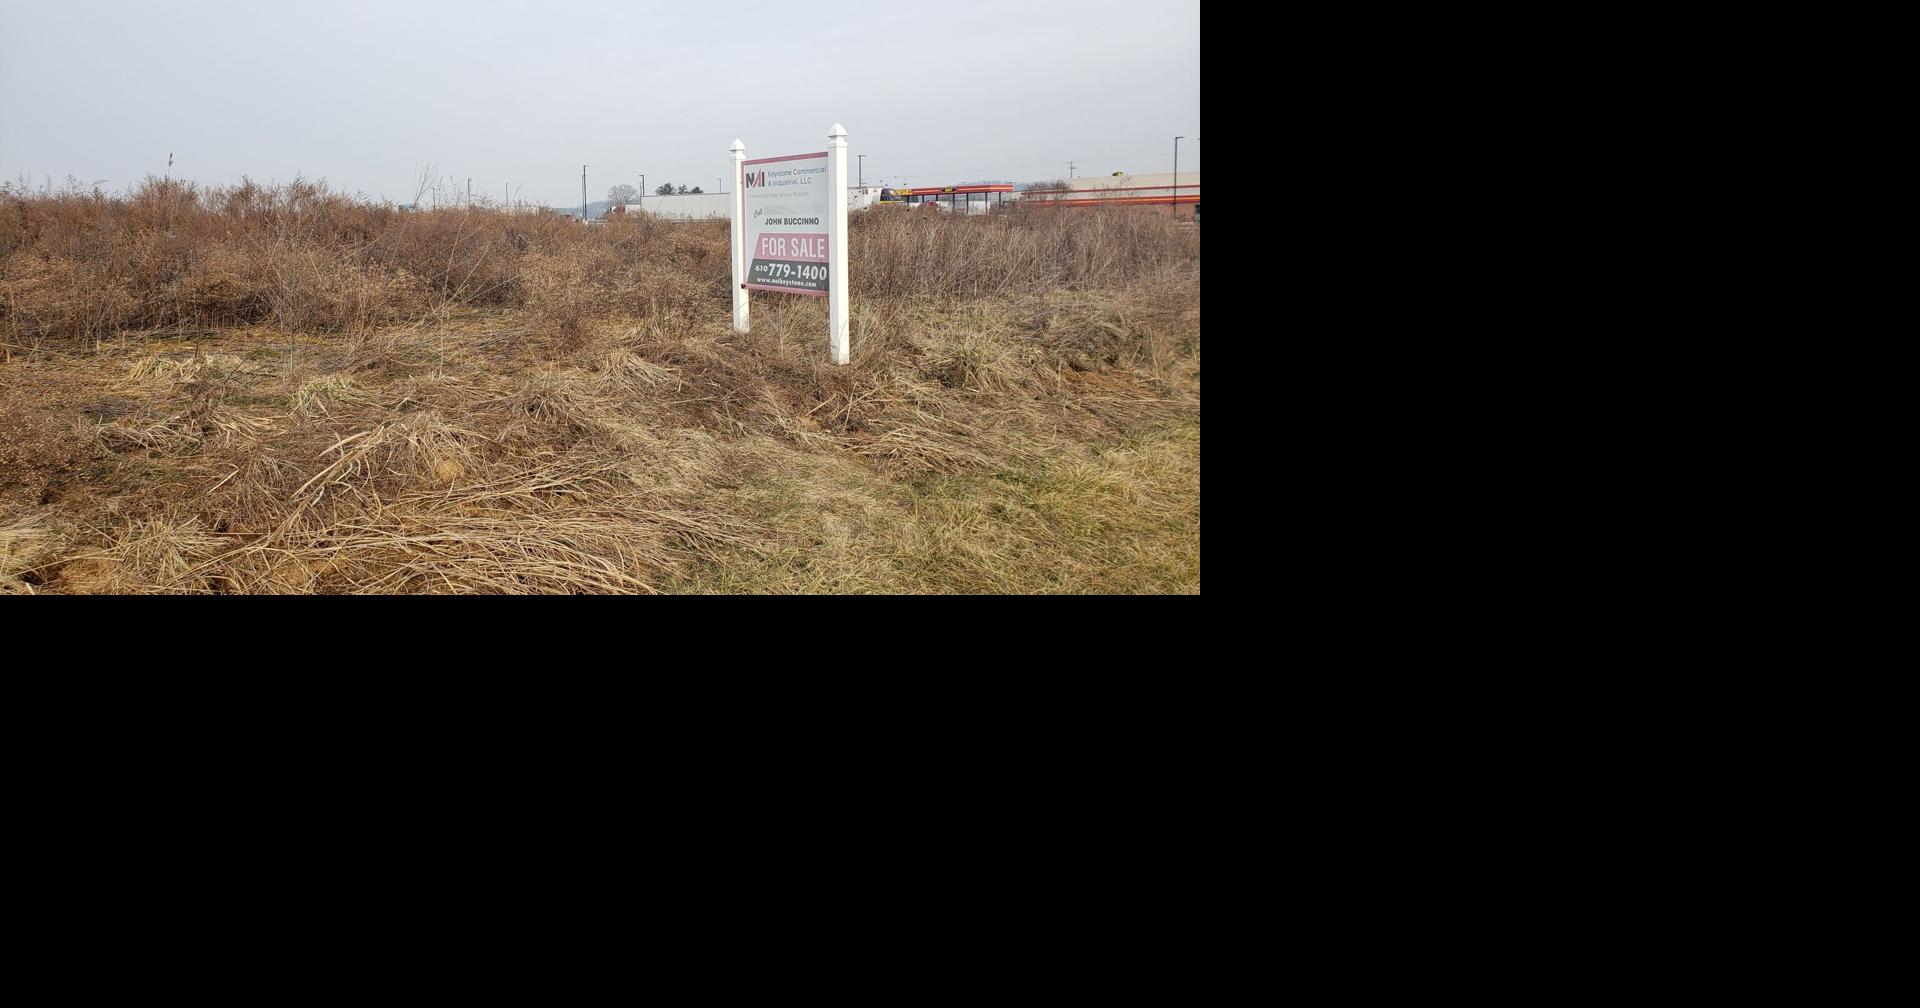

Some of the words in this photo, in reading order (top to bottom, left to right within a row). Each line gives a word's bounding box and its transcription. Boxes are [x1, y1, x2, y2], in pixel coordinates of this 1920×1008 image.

[745, 169, 765, 188] NAI
[768, 170, 792, 178] Keystone
[793, 166, 827, 175] Commercial
[800, 177, 812, 185] LLC
[765, 217, 782, 226] JOHN
[783, 217, 819, 226] BUCCINNO
[761, 237, 786, 257] FOR
[790, 237, 825, 258] SALE
[755, 264, 768, 272] 610
[768, 263, 827, 280] 779-1400
